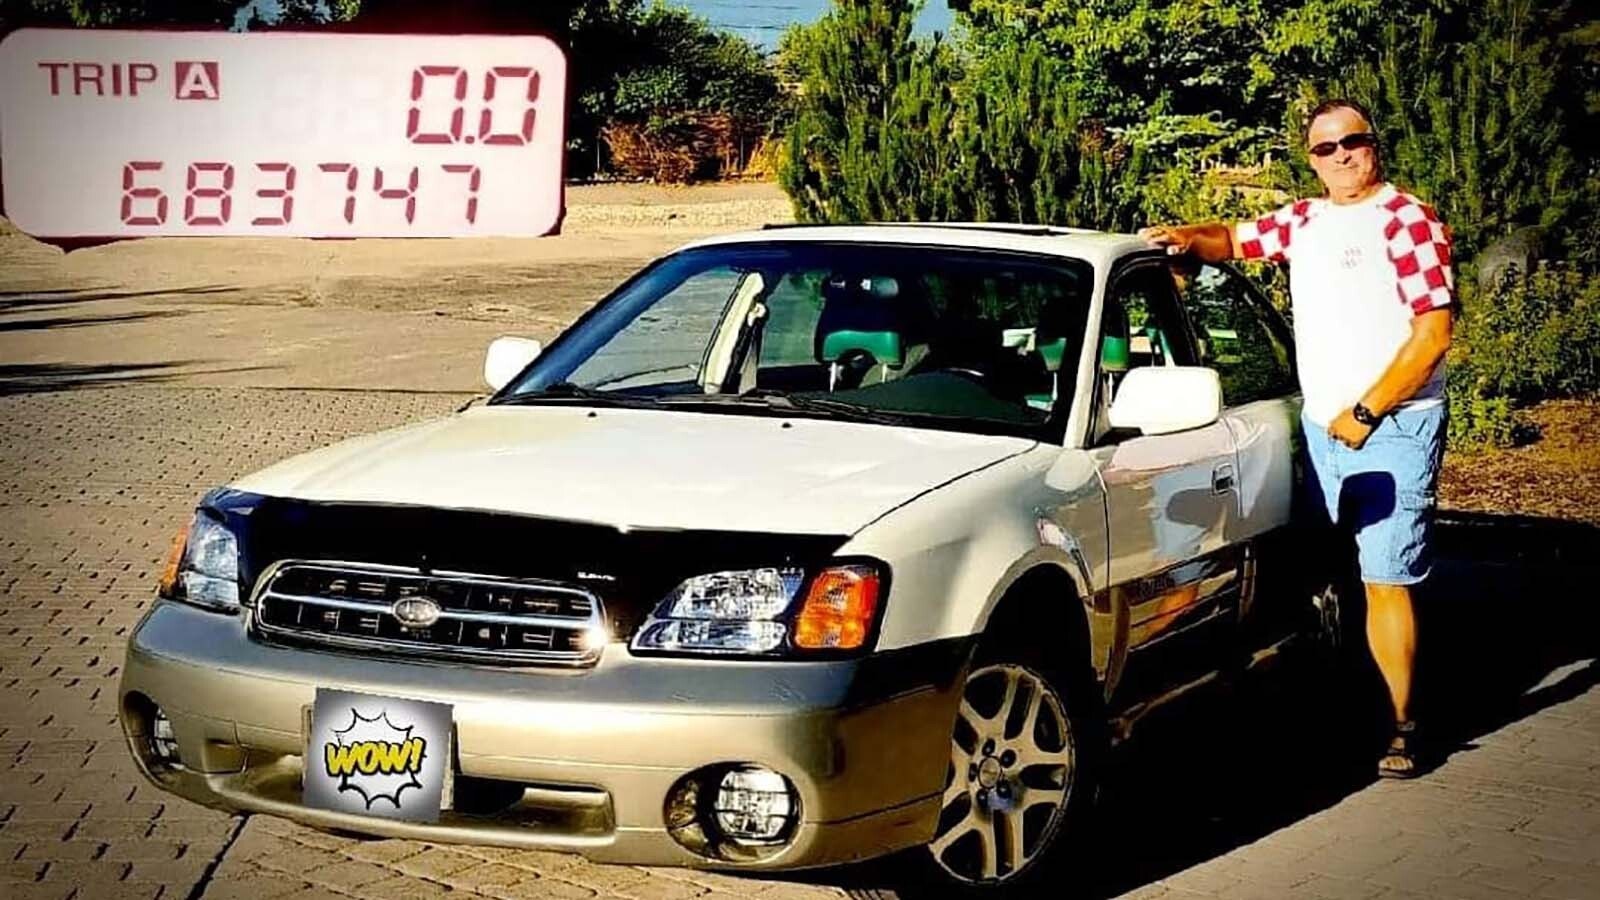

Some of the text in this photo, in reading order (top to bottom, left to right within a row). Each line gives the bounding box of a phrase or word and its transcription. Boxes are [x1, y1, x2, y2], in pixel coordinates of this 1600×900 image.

[38, 61, 219, 100] TRIP A
[407, 66, 541, 145] 0.0
[120, 161, 481, 226] 683747
